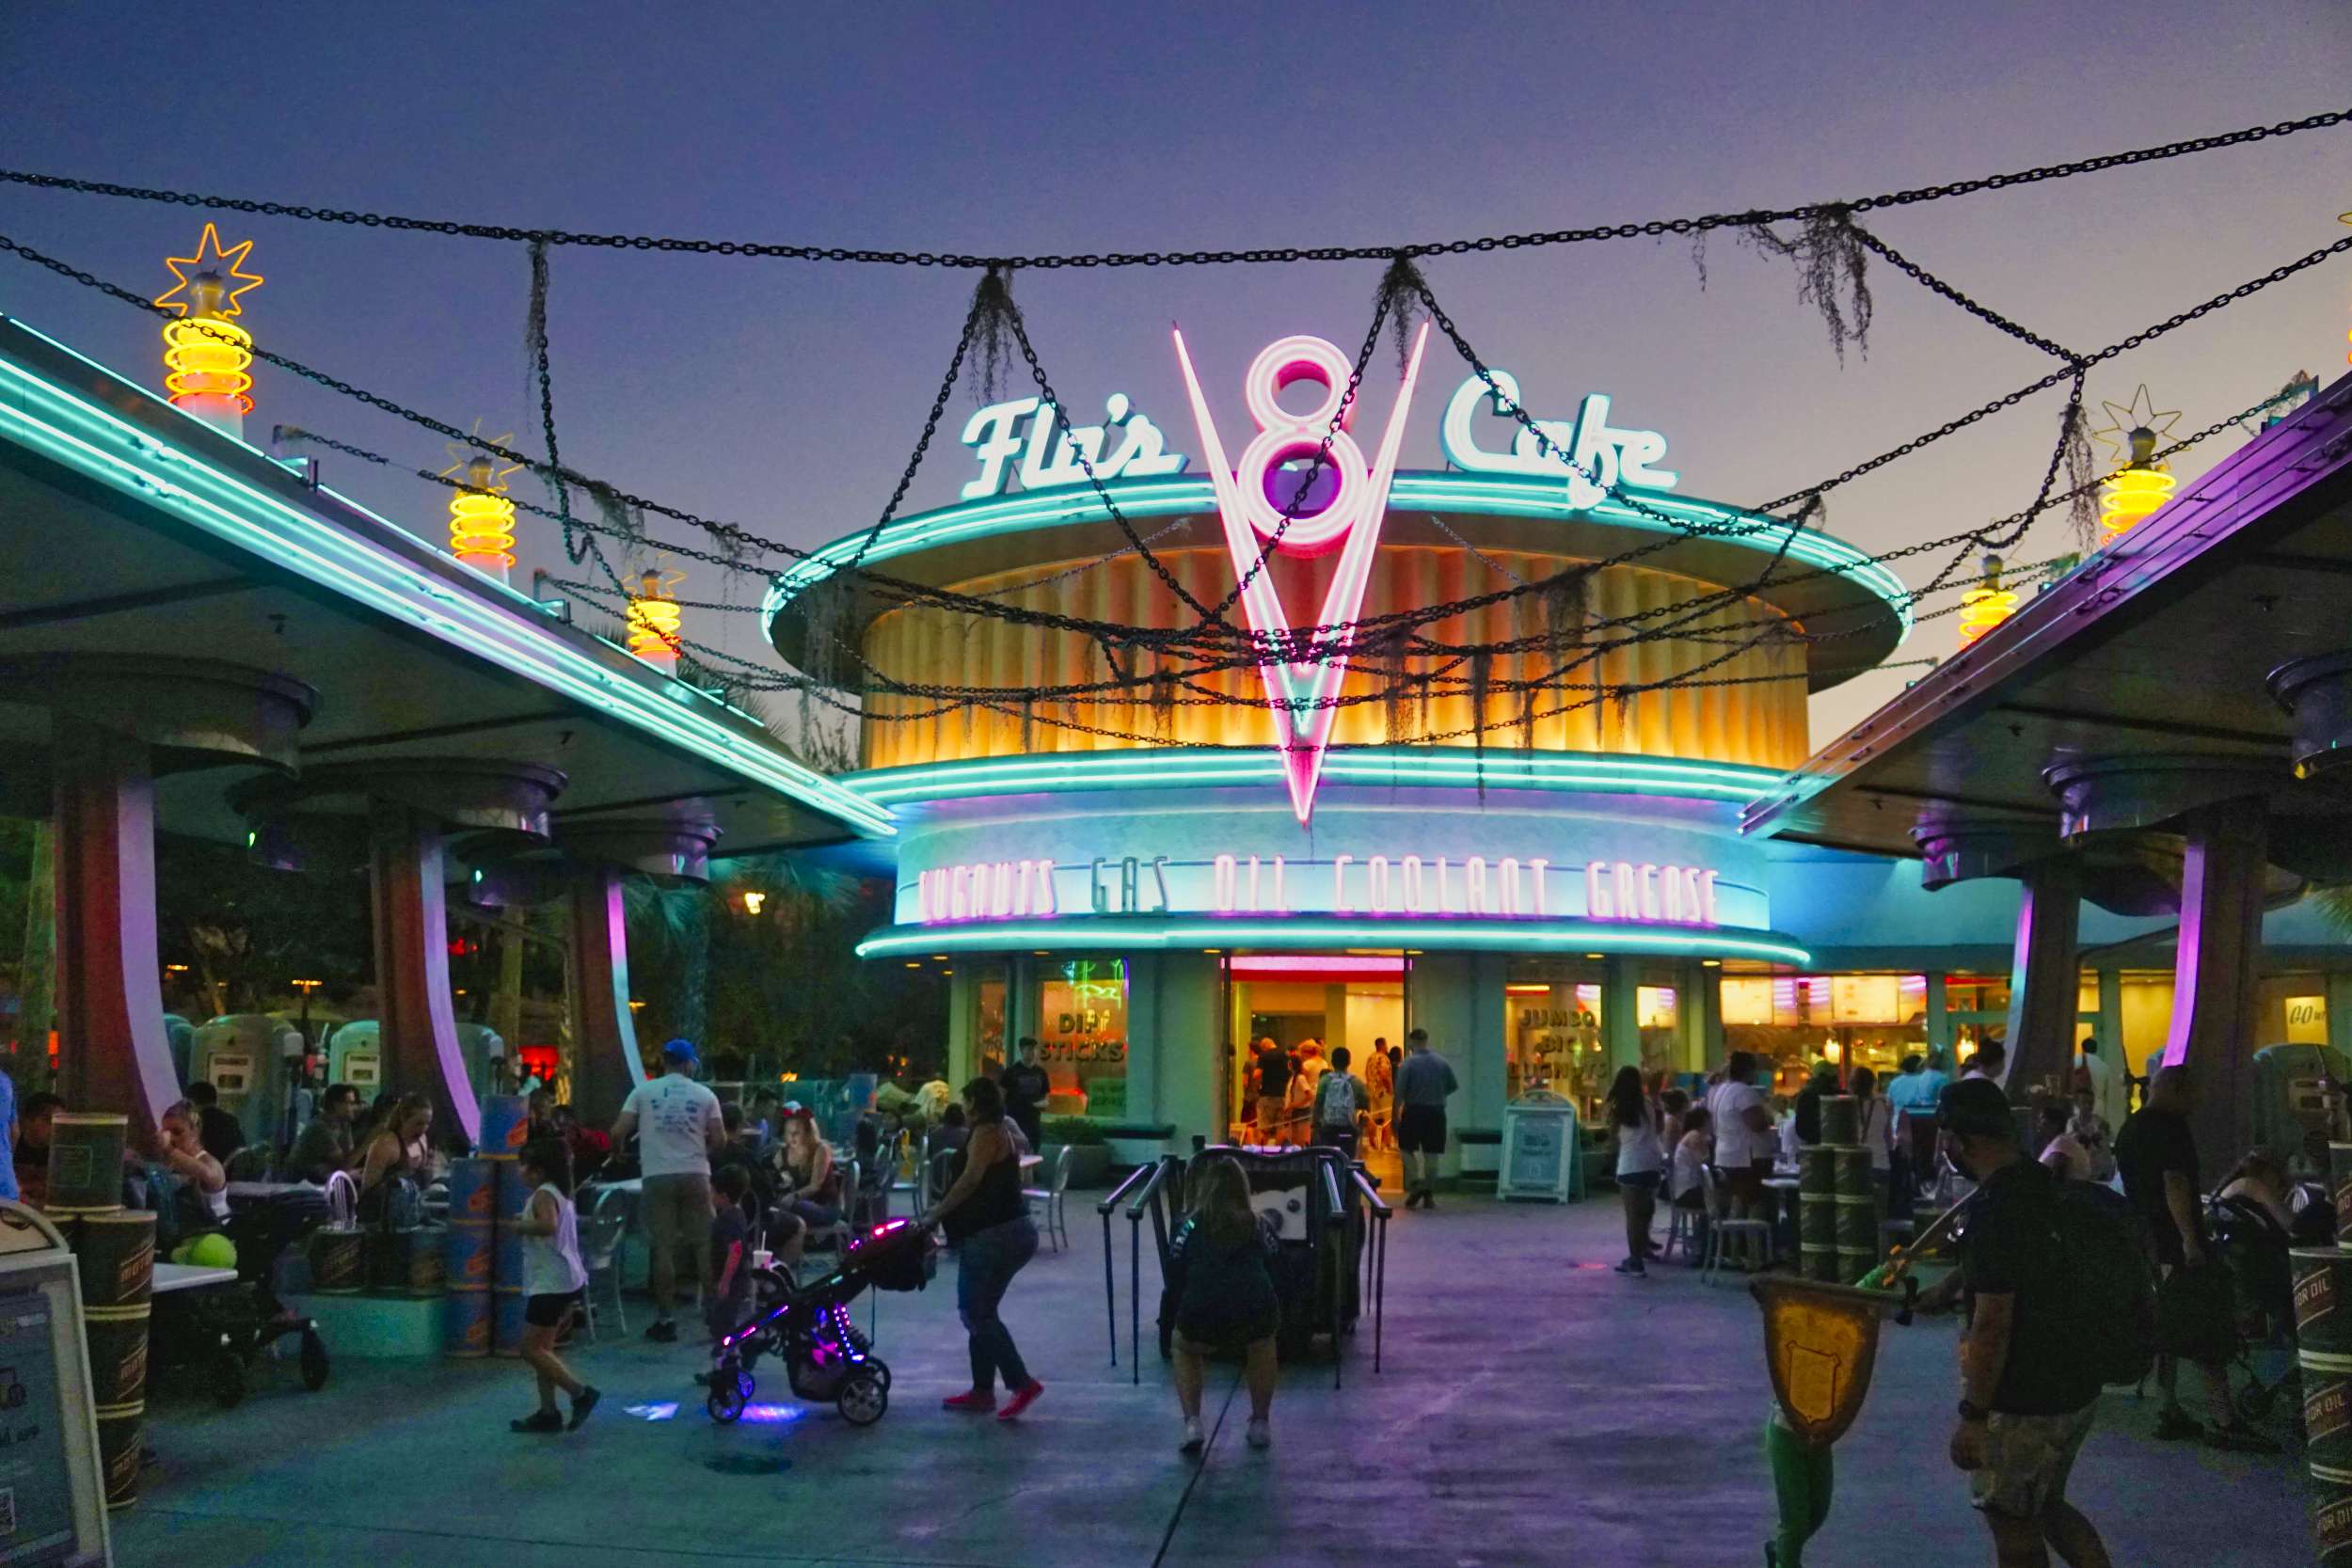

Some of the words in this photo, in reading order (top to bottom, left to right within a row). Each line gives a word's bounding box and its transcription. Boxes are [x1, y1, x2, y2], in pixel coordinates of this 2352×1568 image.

[961, 393, 1191, 501] Flo's
[1091, 855, 1170, 912] GAS
[1215, 853, 1290, 912] OIL
[1333, 855, 1550, 914] COOLANT
[1586, 861, 1720, 922] GREASE
[1058, 1013, 1099, 1034] DIP
[1520, 1009, 1596, 1027] JUMBO
[1041, 1041, 1125, 1063] STICKS
[2311, 1277, 2332, 1298] OIL
[2325, 1392, 2345, 1412] OIL
